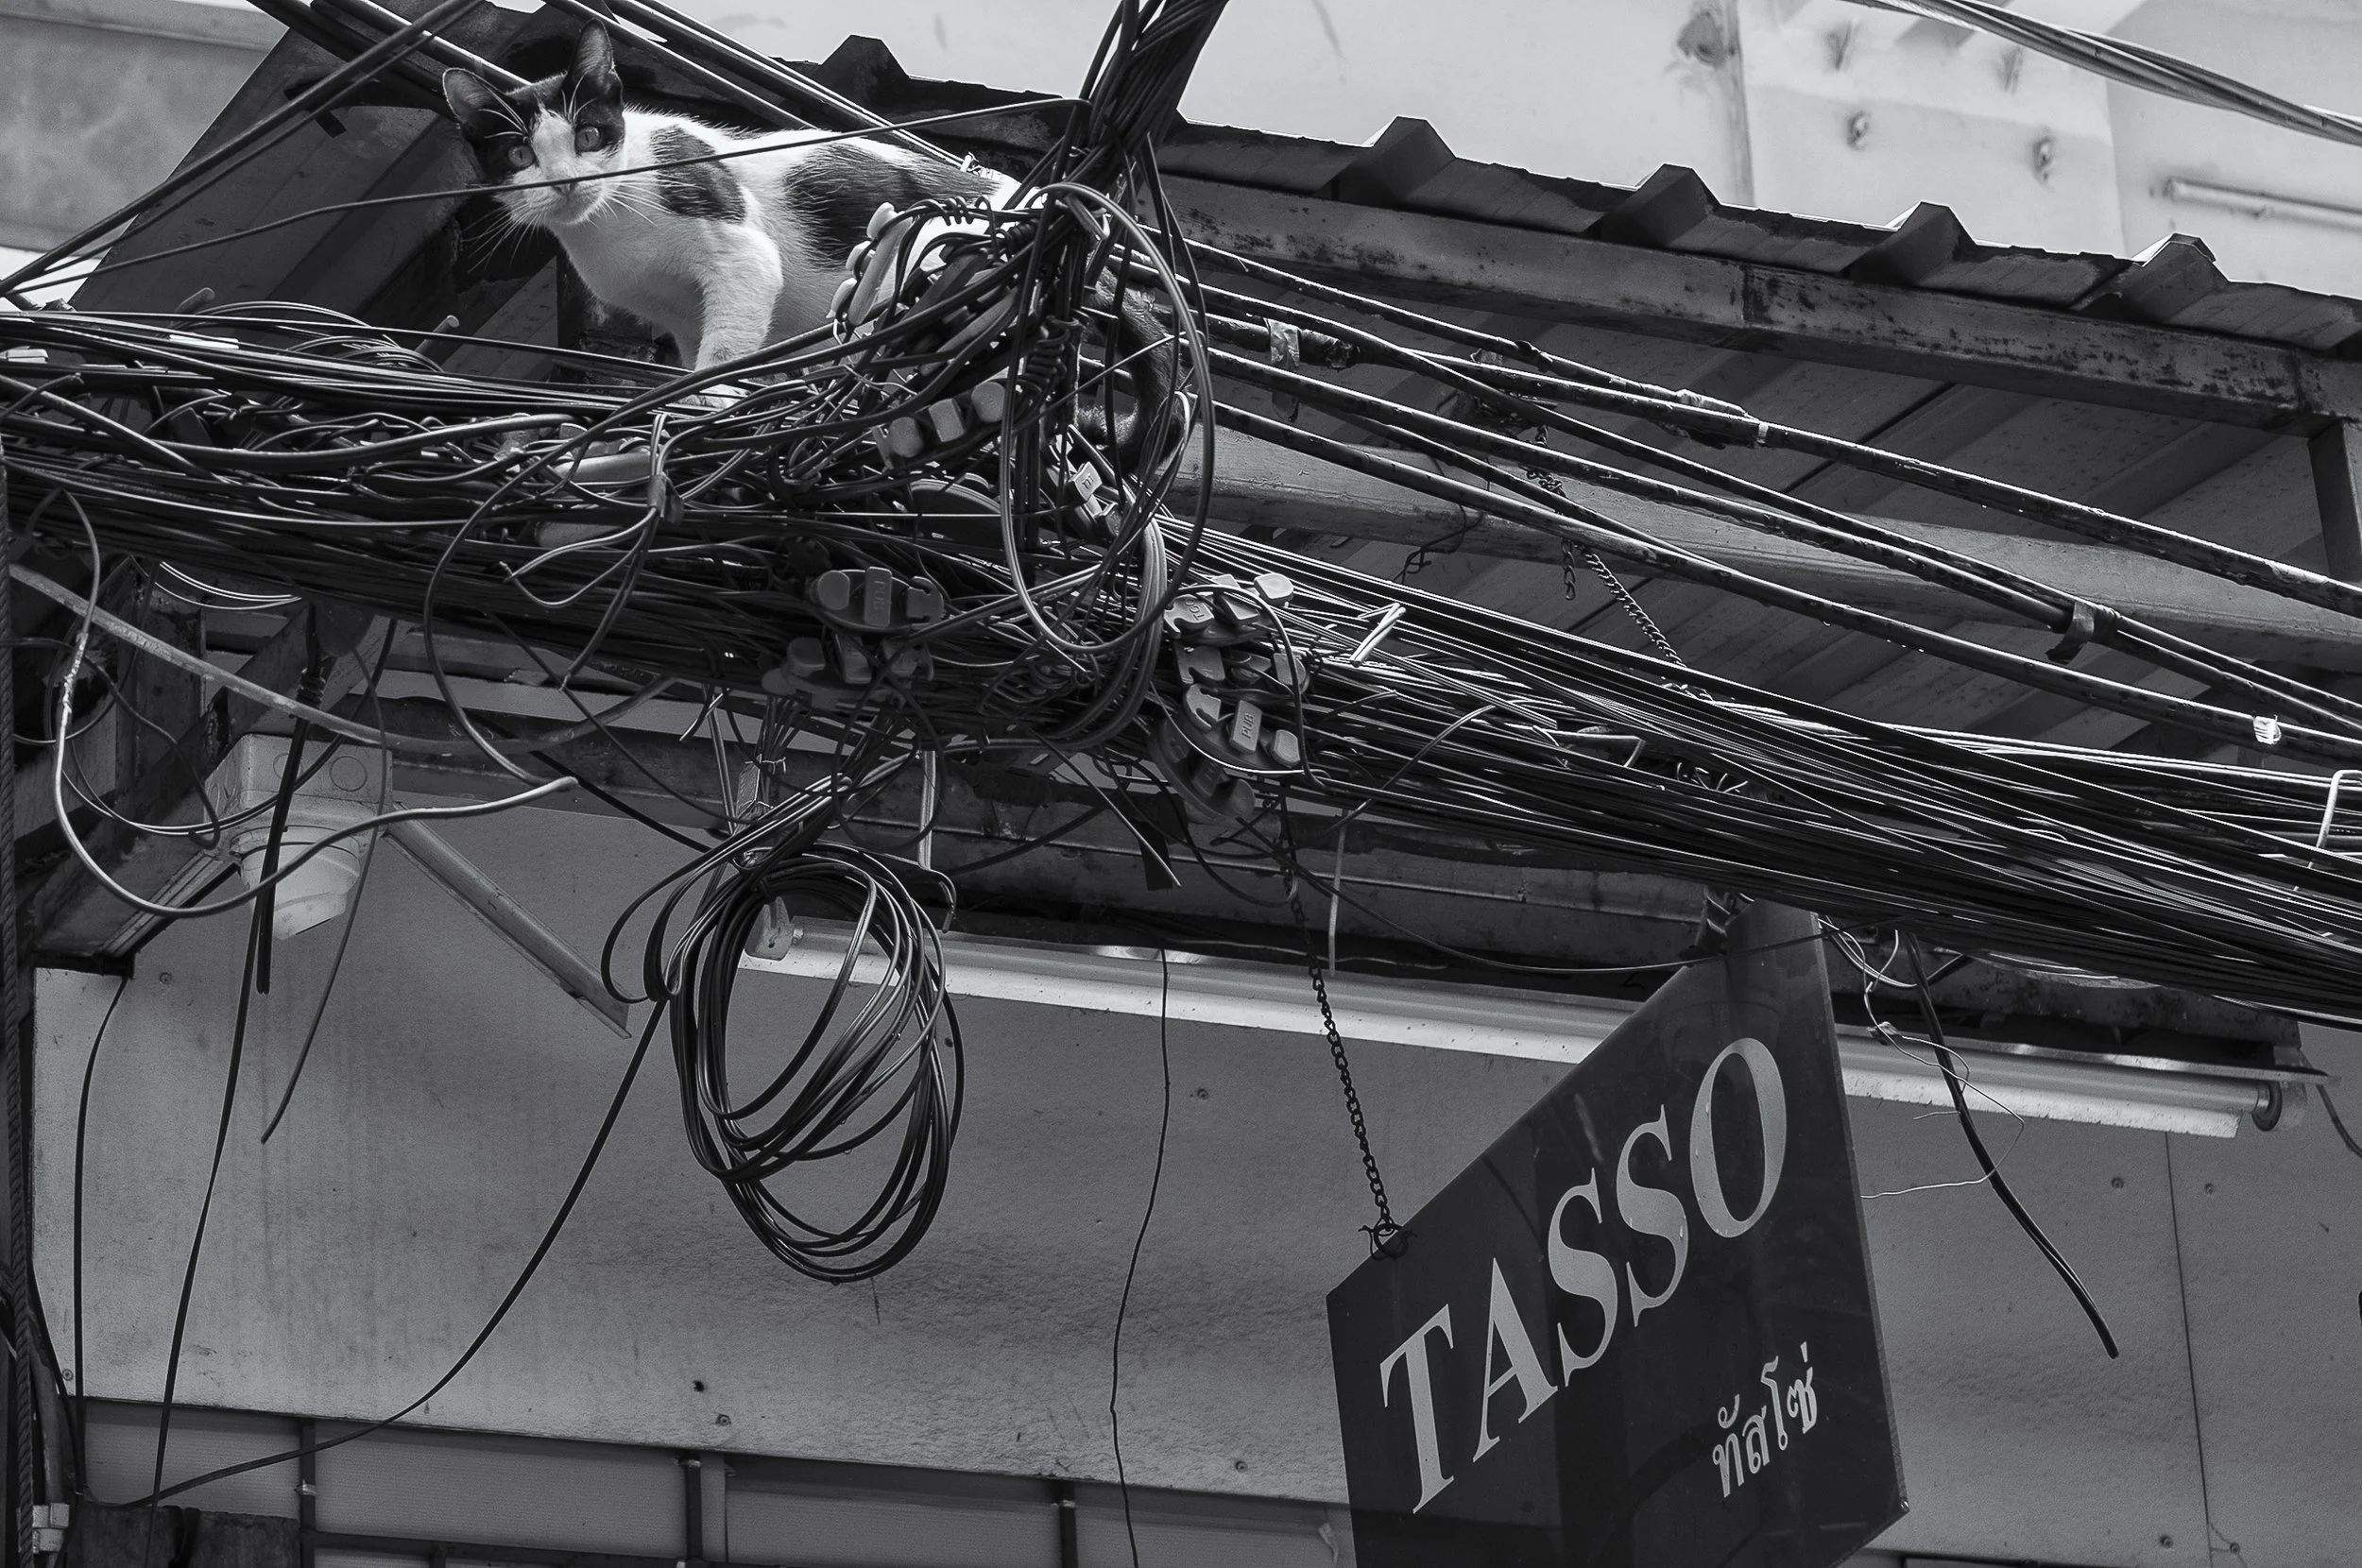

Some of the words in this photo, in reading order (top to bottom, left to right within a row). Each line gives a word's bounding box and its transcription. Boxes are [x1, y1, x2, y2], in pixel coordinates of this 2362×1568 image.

[1241, 713, 1256, 740] PUB
[1379, 1037, 1788, 1514] TASSO
[1712, 1340, 1818, 1498] ทัสโซ่
